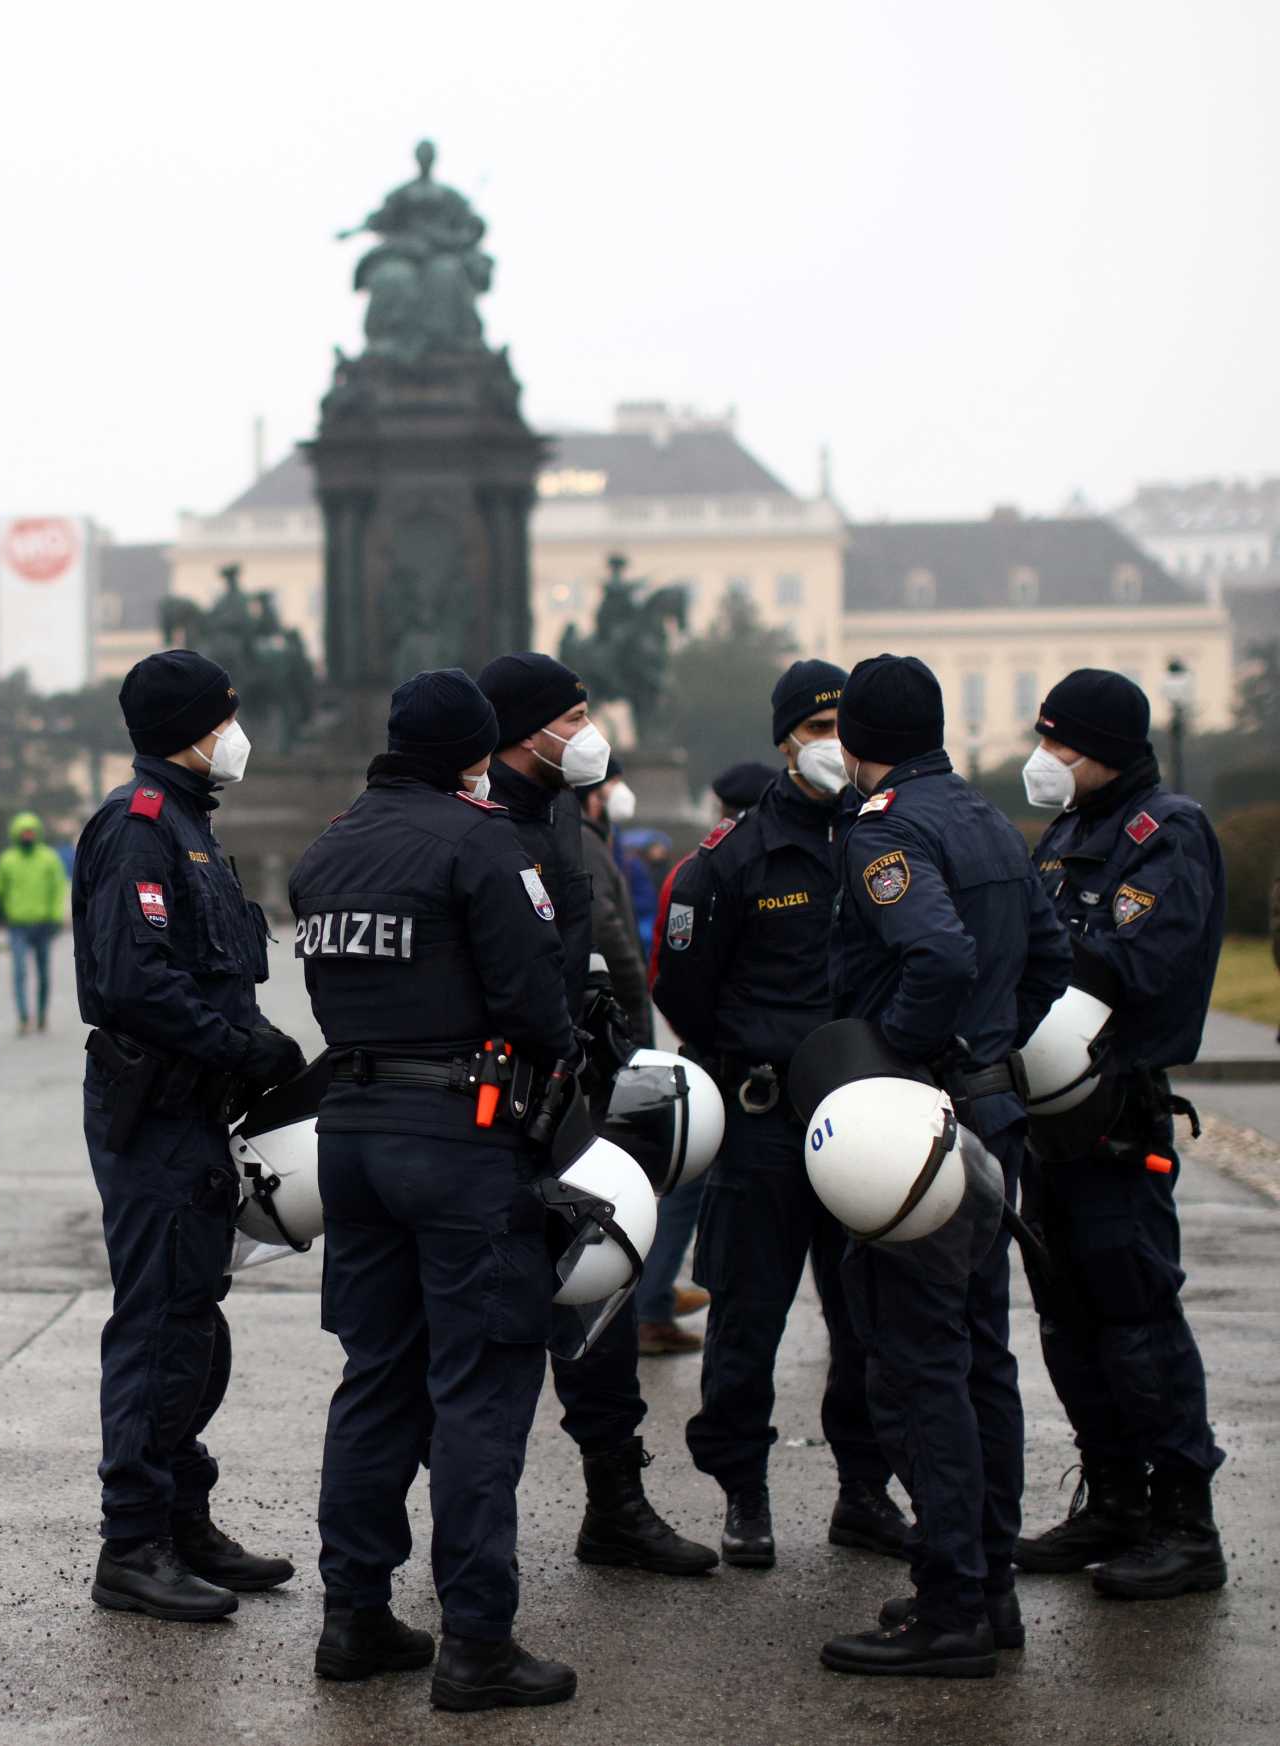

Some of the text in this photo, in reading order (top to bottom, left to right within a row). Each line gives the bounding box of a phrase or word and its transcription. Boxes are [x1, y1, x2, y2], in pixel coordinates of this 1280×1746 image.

[865, 854, 901, 879] POLIZEI
[758, 892, 809, 911] POLIZEI
[295, 911, 413, 958] POLIZEI
